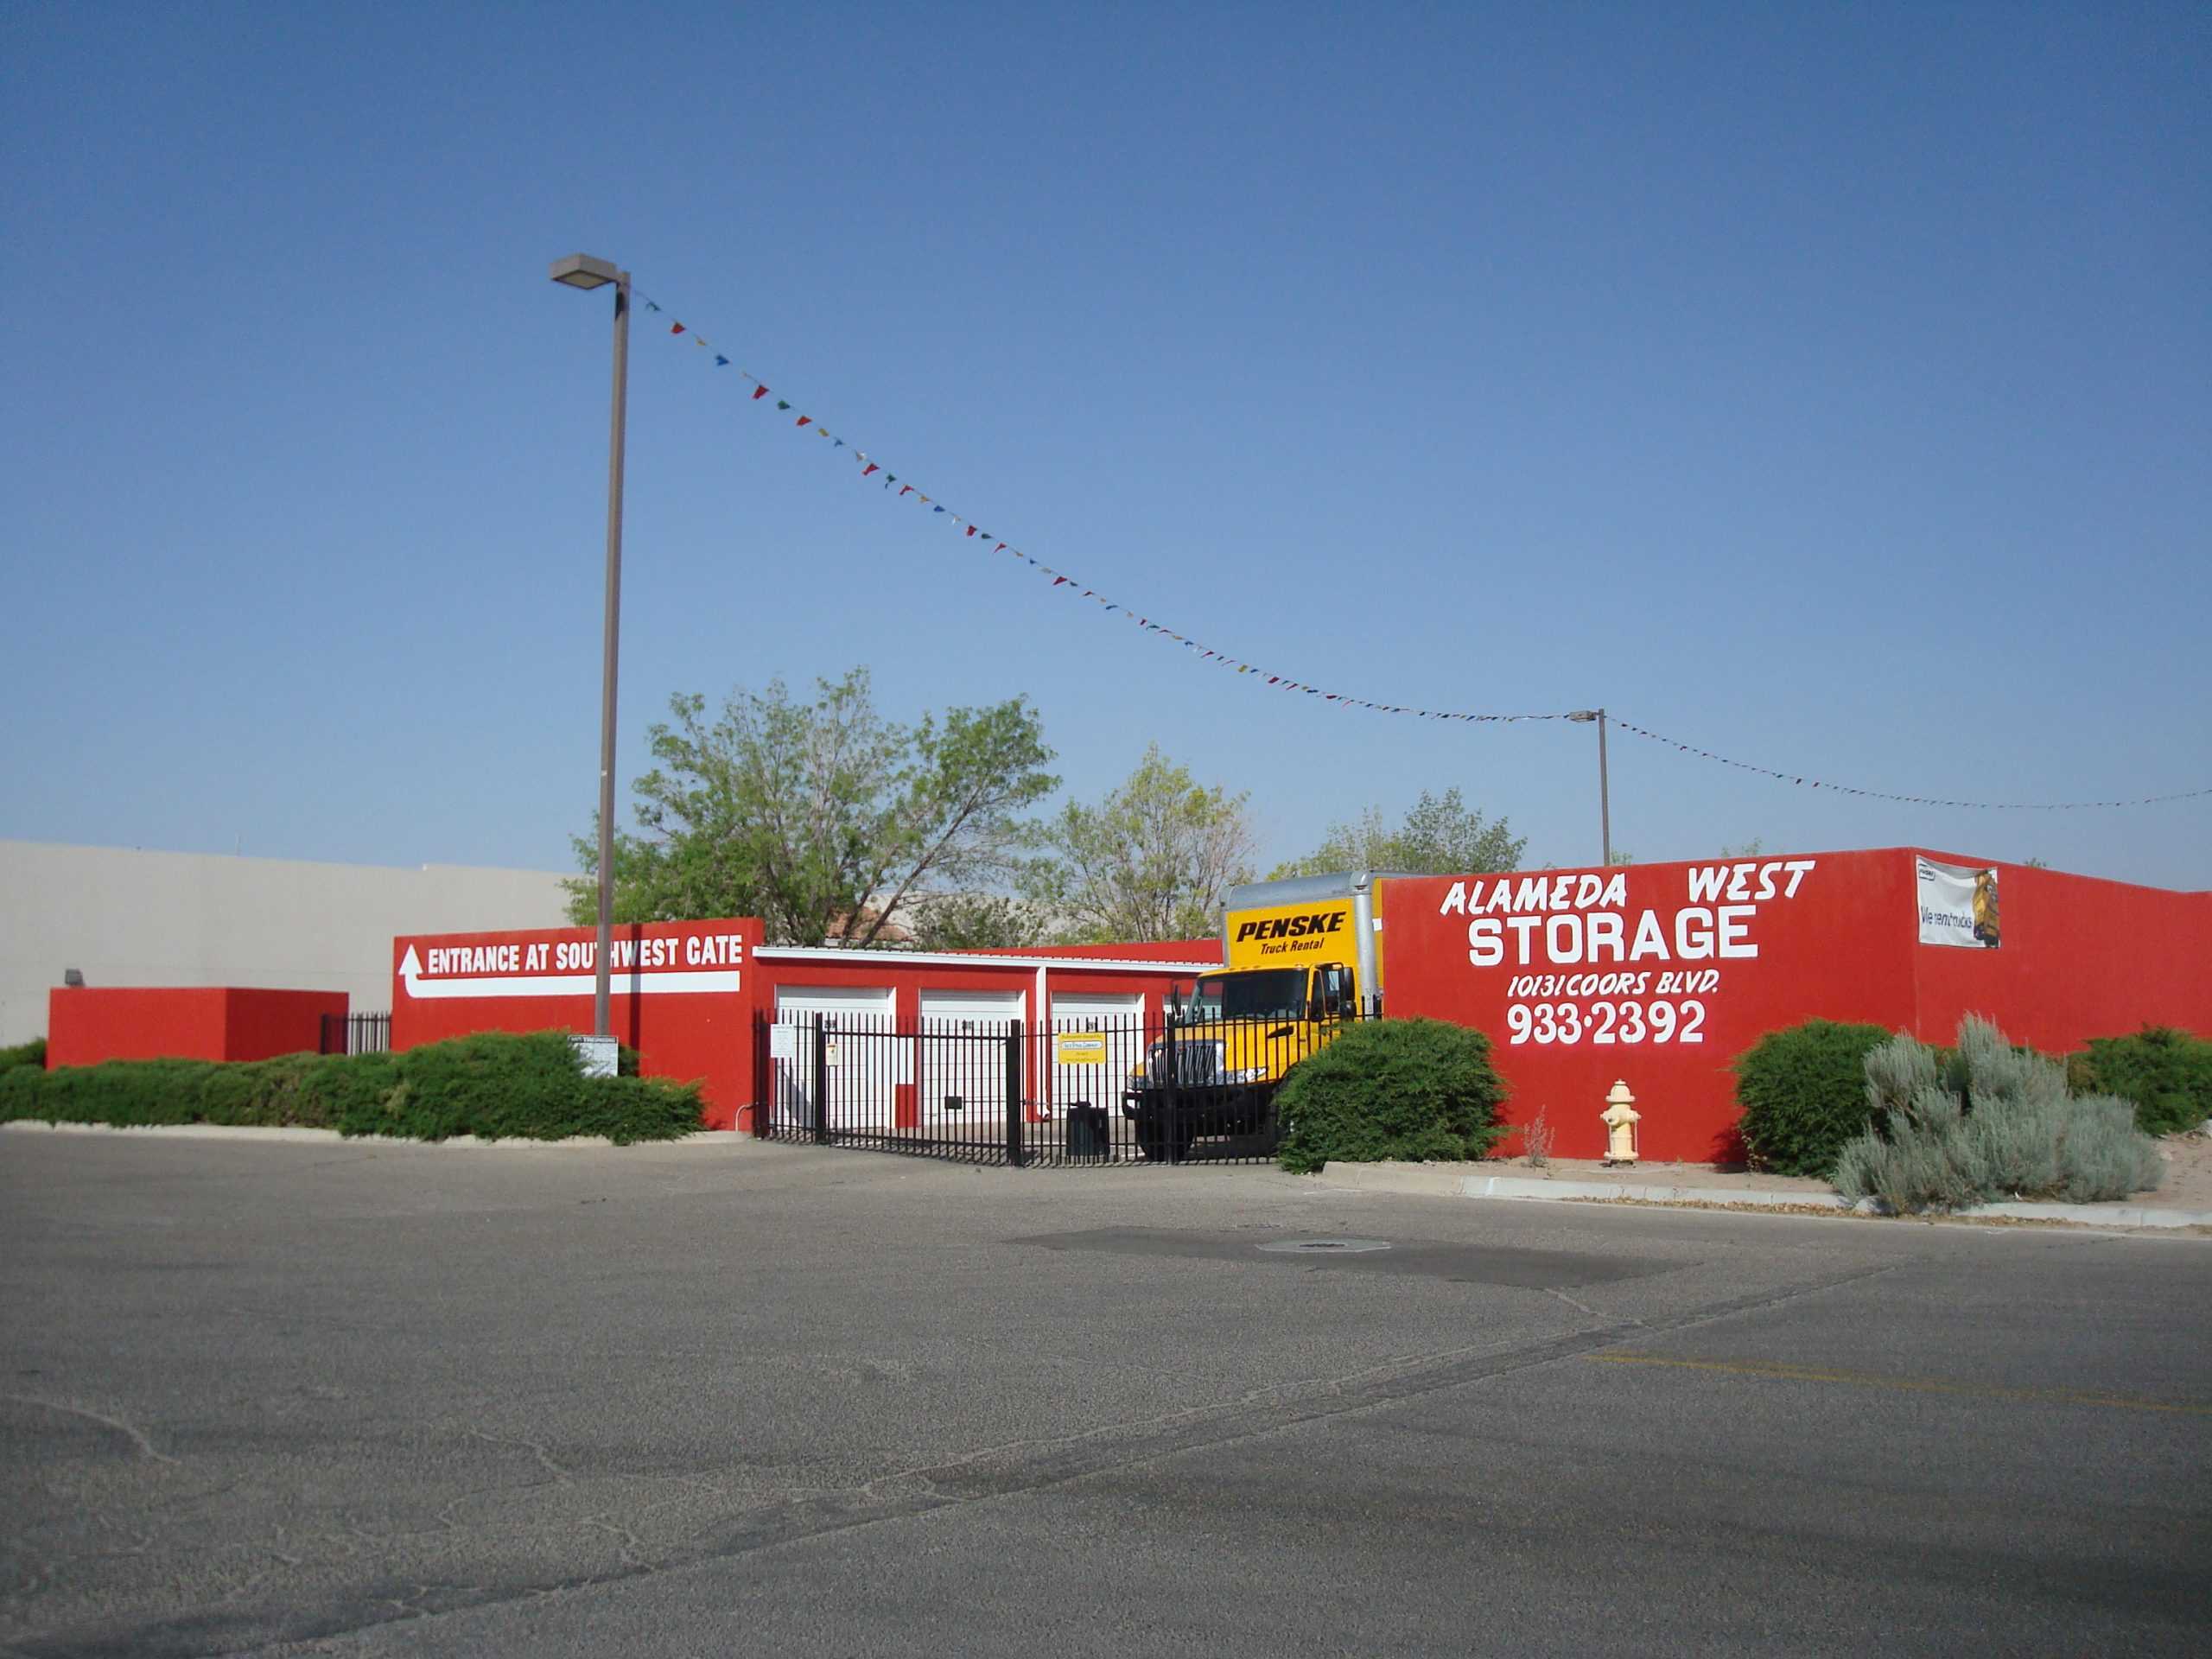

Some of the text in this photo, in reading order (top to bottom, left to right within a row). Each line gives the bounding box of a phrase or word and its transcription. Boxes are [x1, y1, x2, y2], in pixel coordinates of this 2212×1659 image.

[1439, 860, 1817, 916] ALAMEDA WEST
[1236, 911, 1346, 943] PENSKE
[1468, 904, 1758, 967] STORAGE
[428, 935, 742, 975] ENTRANCE AT SOUHWEST GATE
[1261, 938, 1325, 955] Truck Rental
[1566, 971, 1652, 996] COORS
[1655, 969, 1720, 995] BLVD.
